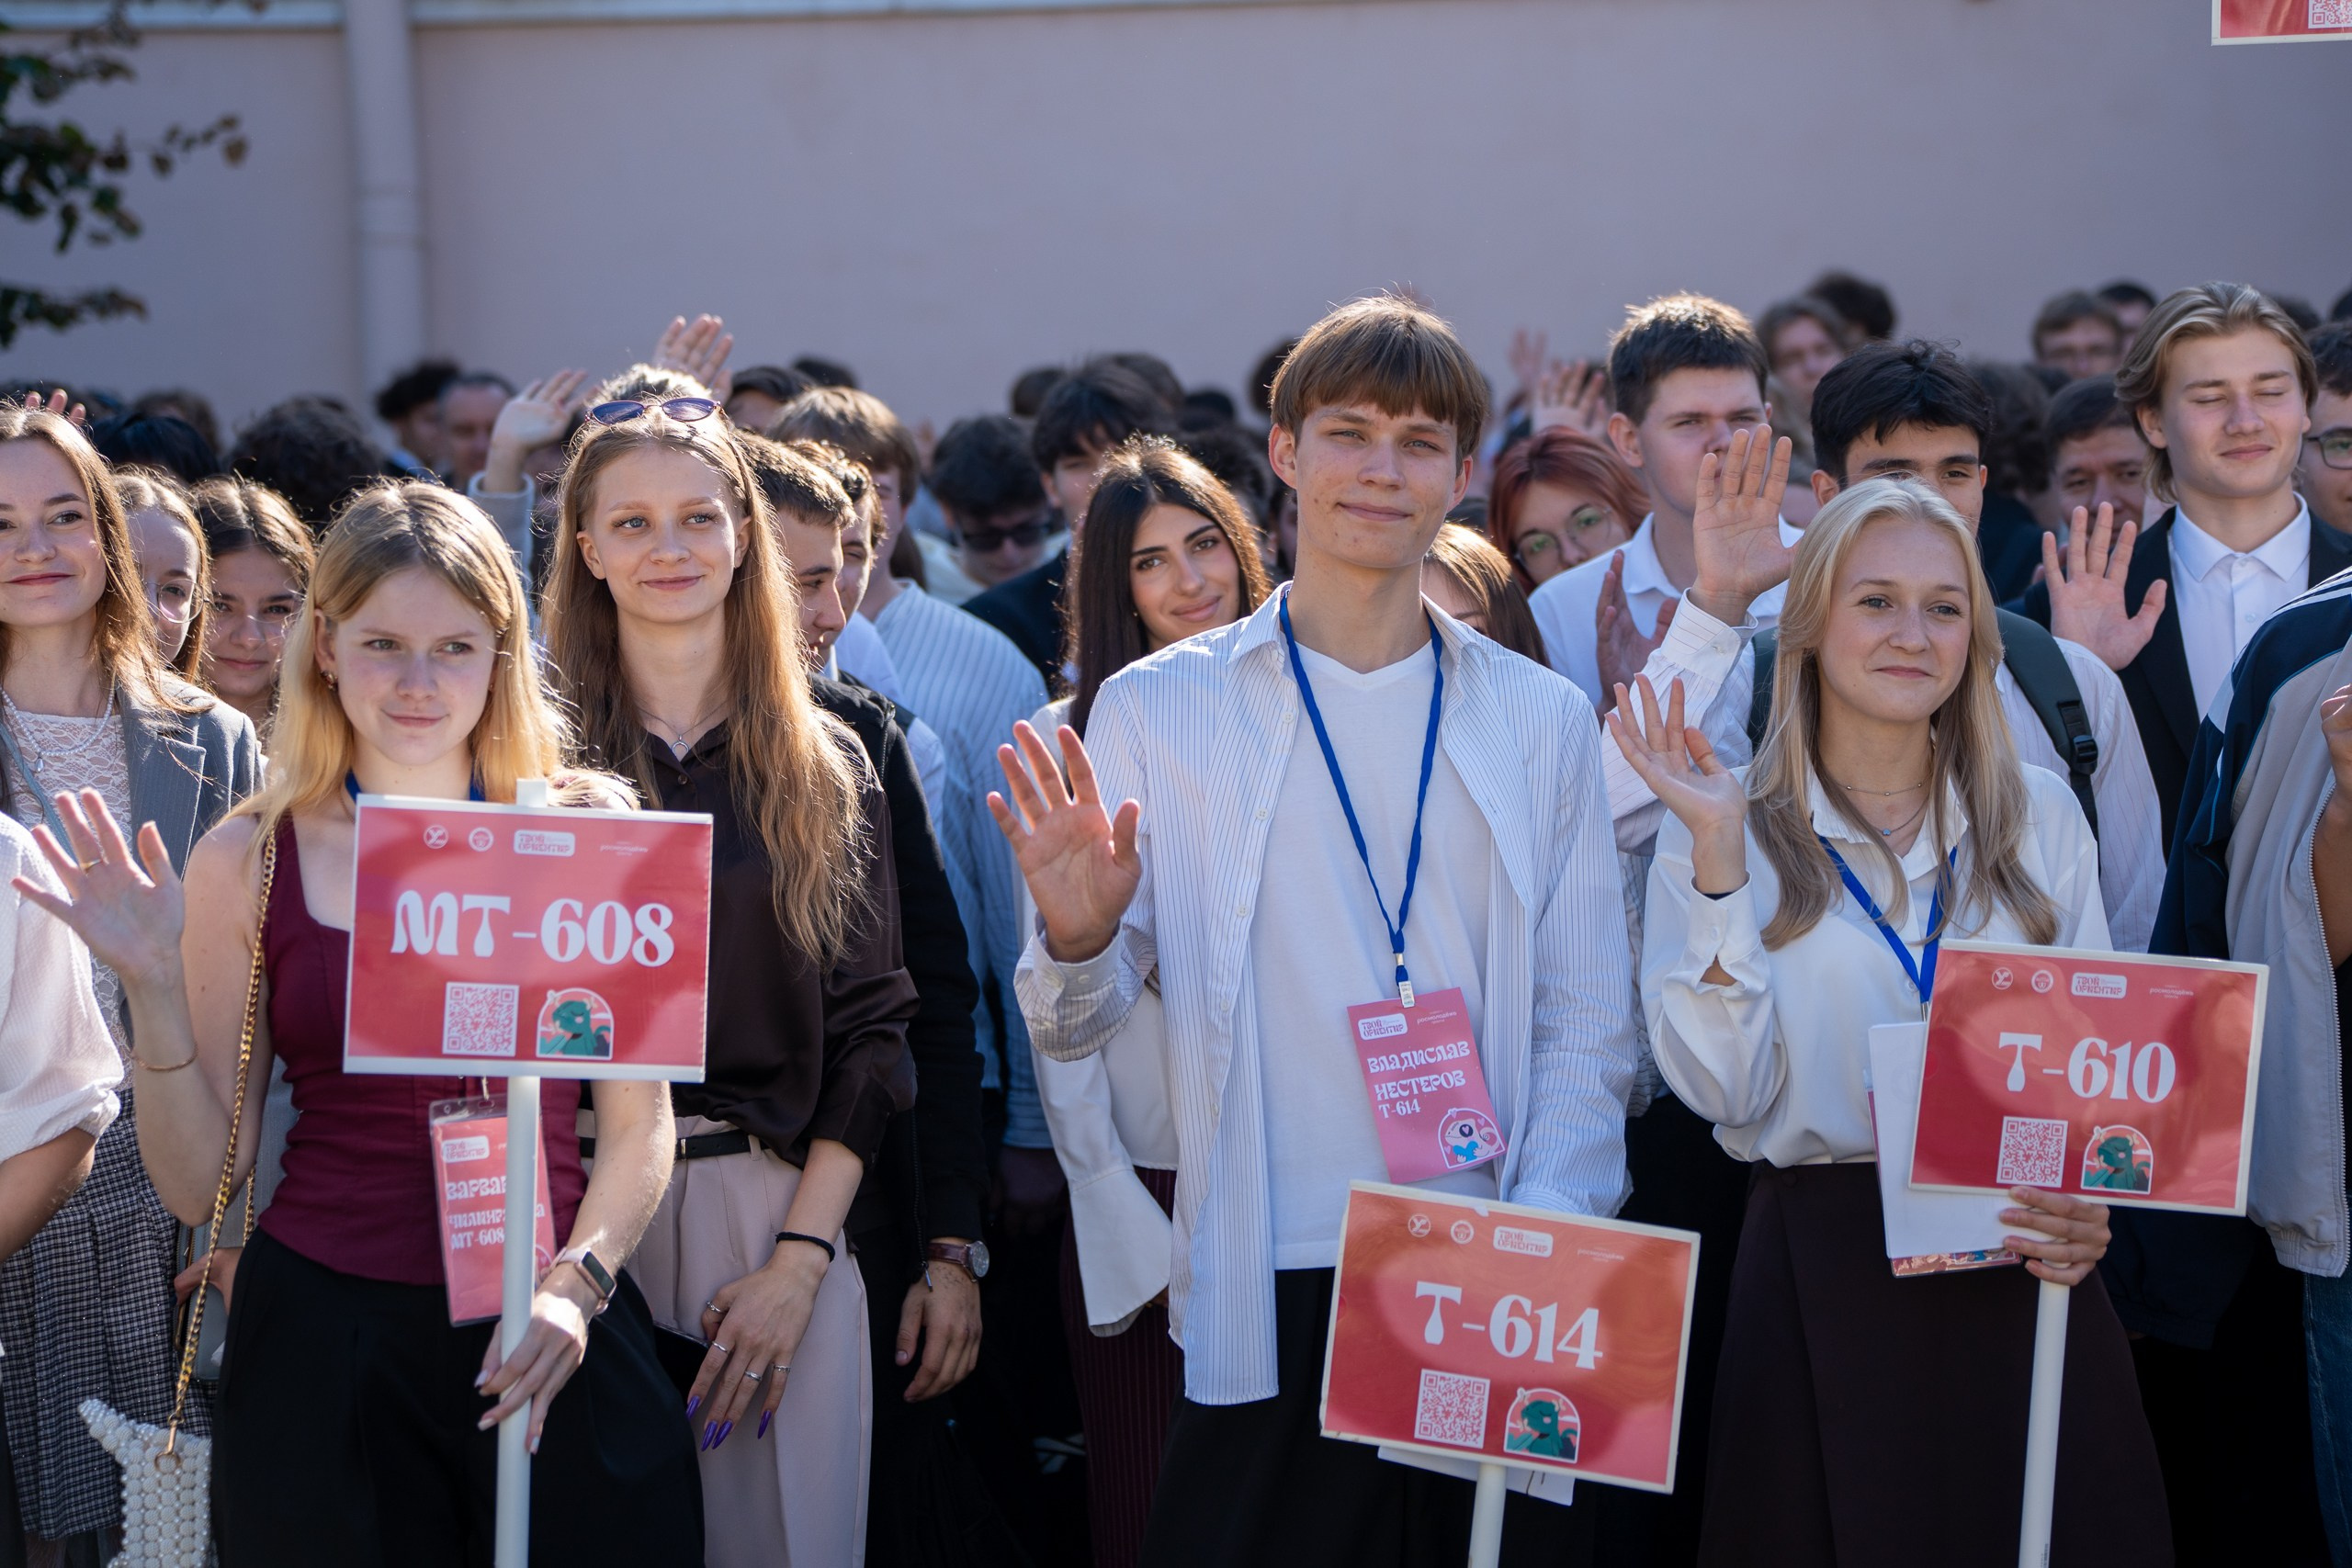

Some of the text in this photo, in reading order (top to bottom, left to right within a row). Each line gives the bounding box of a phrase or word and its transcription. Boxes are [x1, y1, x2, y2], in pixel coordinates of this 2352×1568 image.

[390, 889, 674, 967] МТ-608
[2076, 976, 2099, 986] ТВОЙ
[1362, 1019, 1383, 1031] ТВОЙ
[1367, 1040, 1471, 1074] ВЛАДИСЛАВ
[1999, 1032, 2177, 1103] Т-610
[1374, 1069, 1466, 1100] НЕСТЕРОВ
[1378, 1099, 1421, 1119] Т-614
[1415, 1281, 1604, 1371] Т-614
